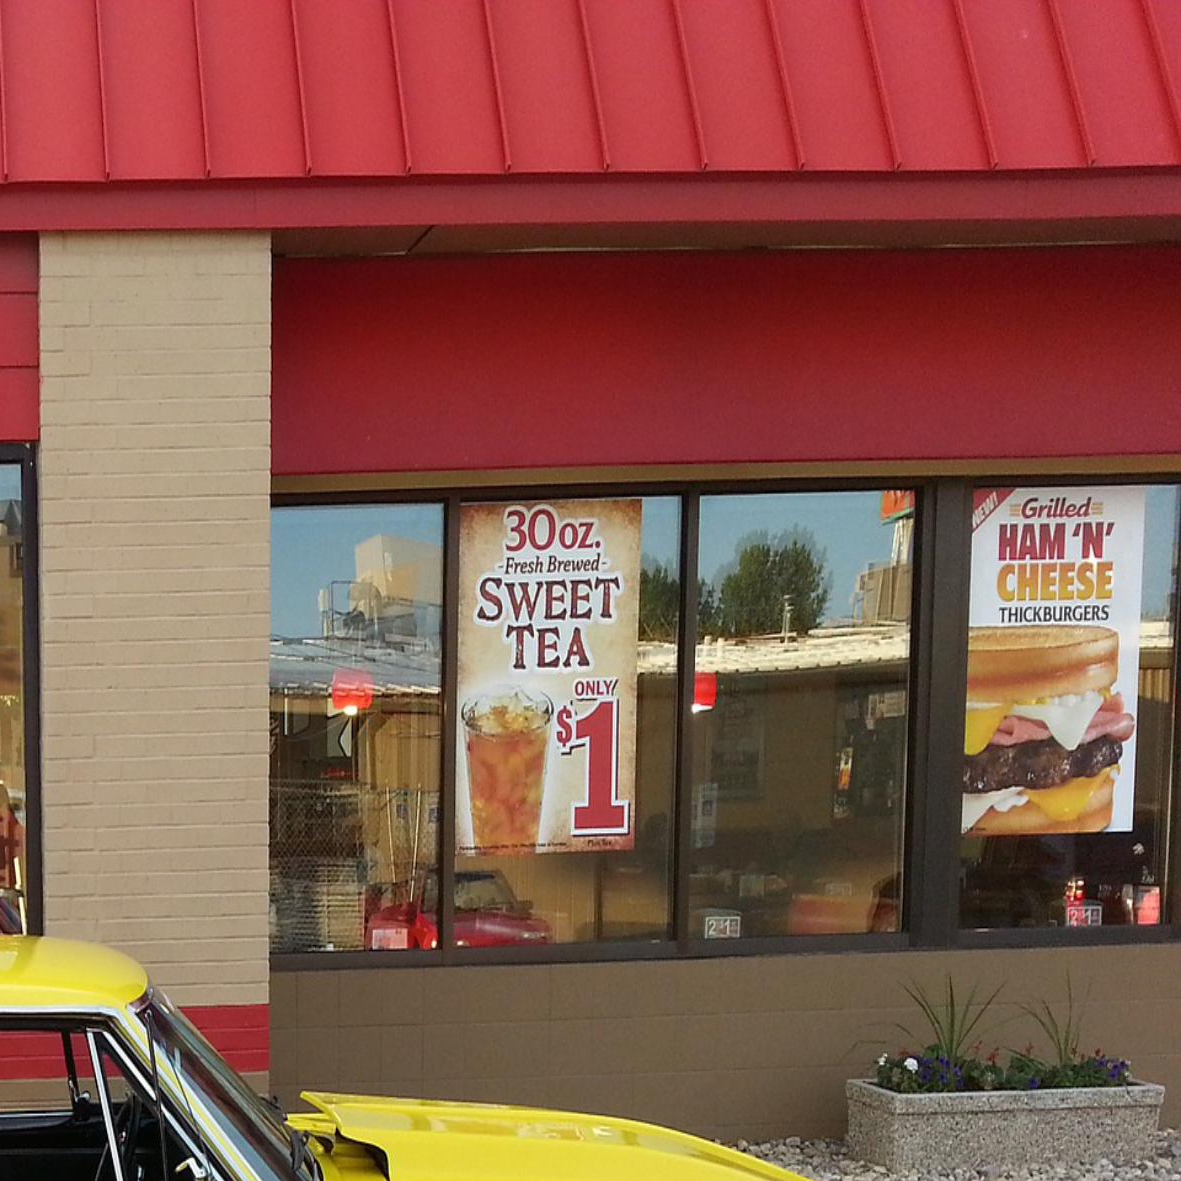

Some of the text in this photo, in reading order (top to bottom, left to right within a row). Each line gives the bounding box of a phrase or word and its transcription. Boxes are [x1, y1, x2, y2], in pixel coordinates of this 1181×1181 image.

[1020, 497, 1092, 519] Grilled
[505, 508, 601, 551] 30 oz.
[998, 523, 1066, 561] HAM
[477, 576, 620, 622] SWEET
[996, 562, 1113, 602] CHEESE
[998, 605, 1110, 623] THICKBURGERS
[506, 623, 590, 669] TEA
[574, 680, 613, 696] ONLY
